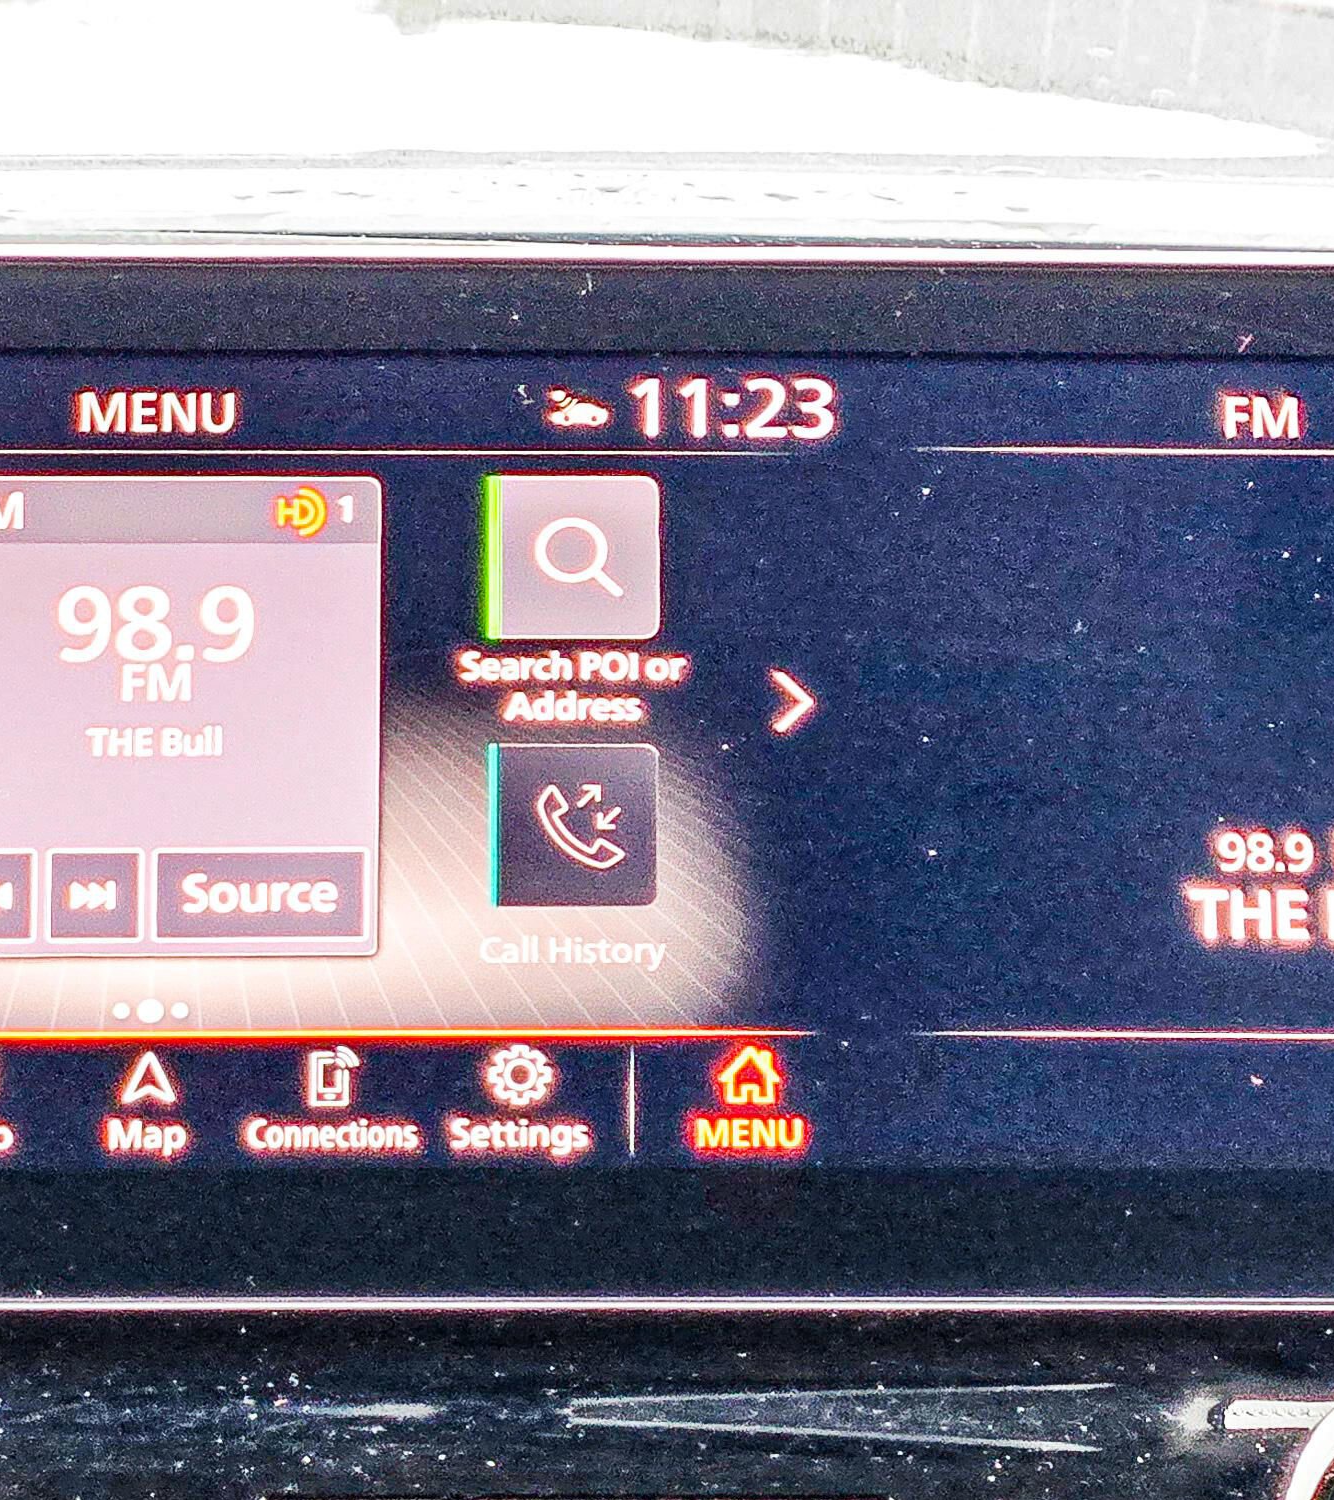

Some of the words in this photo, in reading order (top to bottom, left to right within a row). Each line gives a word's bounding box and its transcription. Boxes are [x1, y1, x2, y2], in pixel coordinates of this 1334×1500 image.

[78, 391, 236, 435] MENU
[630, 377, 836, 440] 11:23
[1223, 395, 1300, 440] FM
[337, 496, 353, 523] 1
[57, 585, 255, 663] 98.9
[121, 664, 192, 702] FM
[458, 651, 573, 681] Search
[580, 651, 638, 681] POI
[648, 656, 688, 681] or
[503, 693, 643, 722] Address
[87, 727, 153, 758] THE
[161, 725, 223, 758] Bull
[1216, 832, 1316, 873] 98.9
[180, 873, 339, 915] Source
[1186, 886, 1310, 942] THE
[478, 935, 540, 965] Call
[548, 937, 666, 973] History
[107, 1119, 187, 1157] Map
[247, 1118, 420, 1151] Connections
[449, 1118, 590, 1157] Settings
[695, 1118, 805, 1150] MENU
